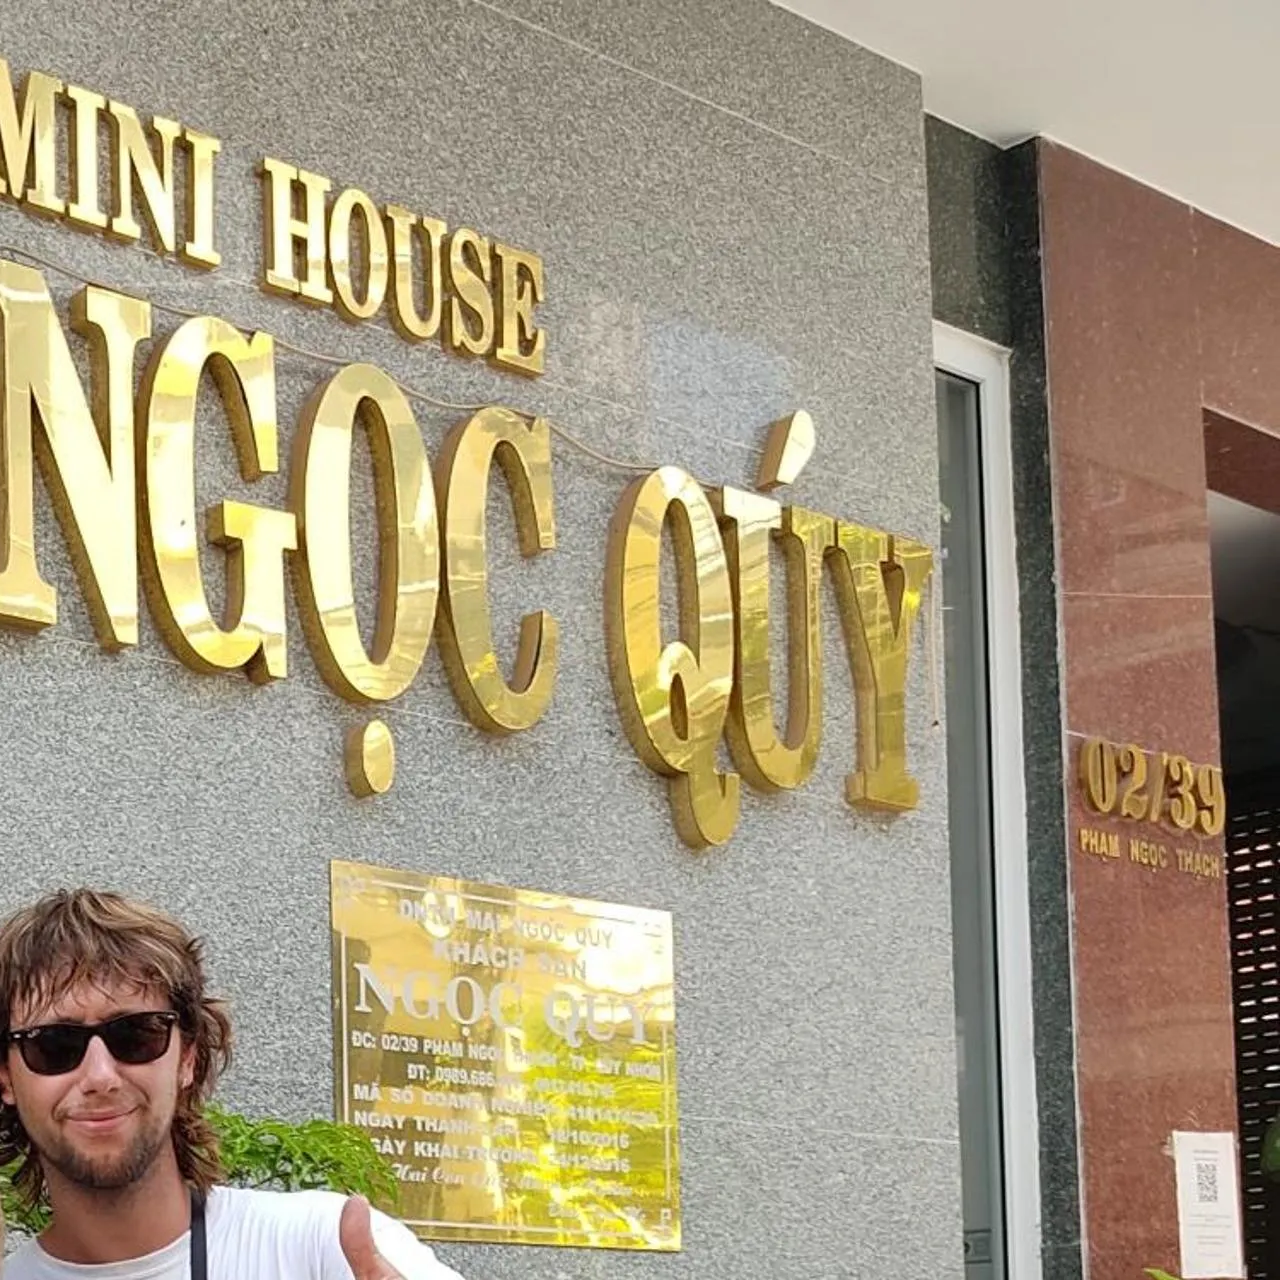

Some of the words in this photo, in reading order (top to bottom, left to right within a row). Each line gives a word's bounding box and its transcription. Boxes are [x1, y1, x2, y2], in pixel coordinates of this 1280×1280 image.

[258, 156, 545, 376] HOUSE
[1080, 737, 1226, 836] 02/39
[354, 963, 523, 1037] NGỌC
[381, 1034, 418, 1053] 02/39
[370, 1134, 407, 1157] GÀY
